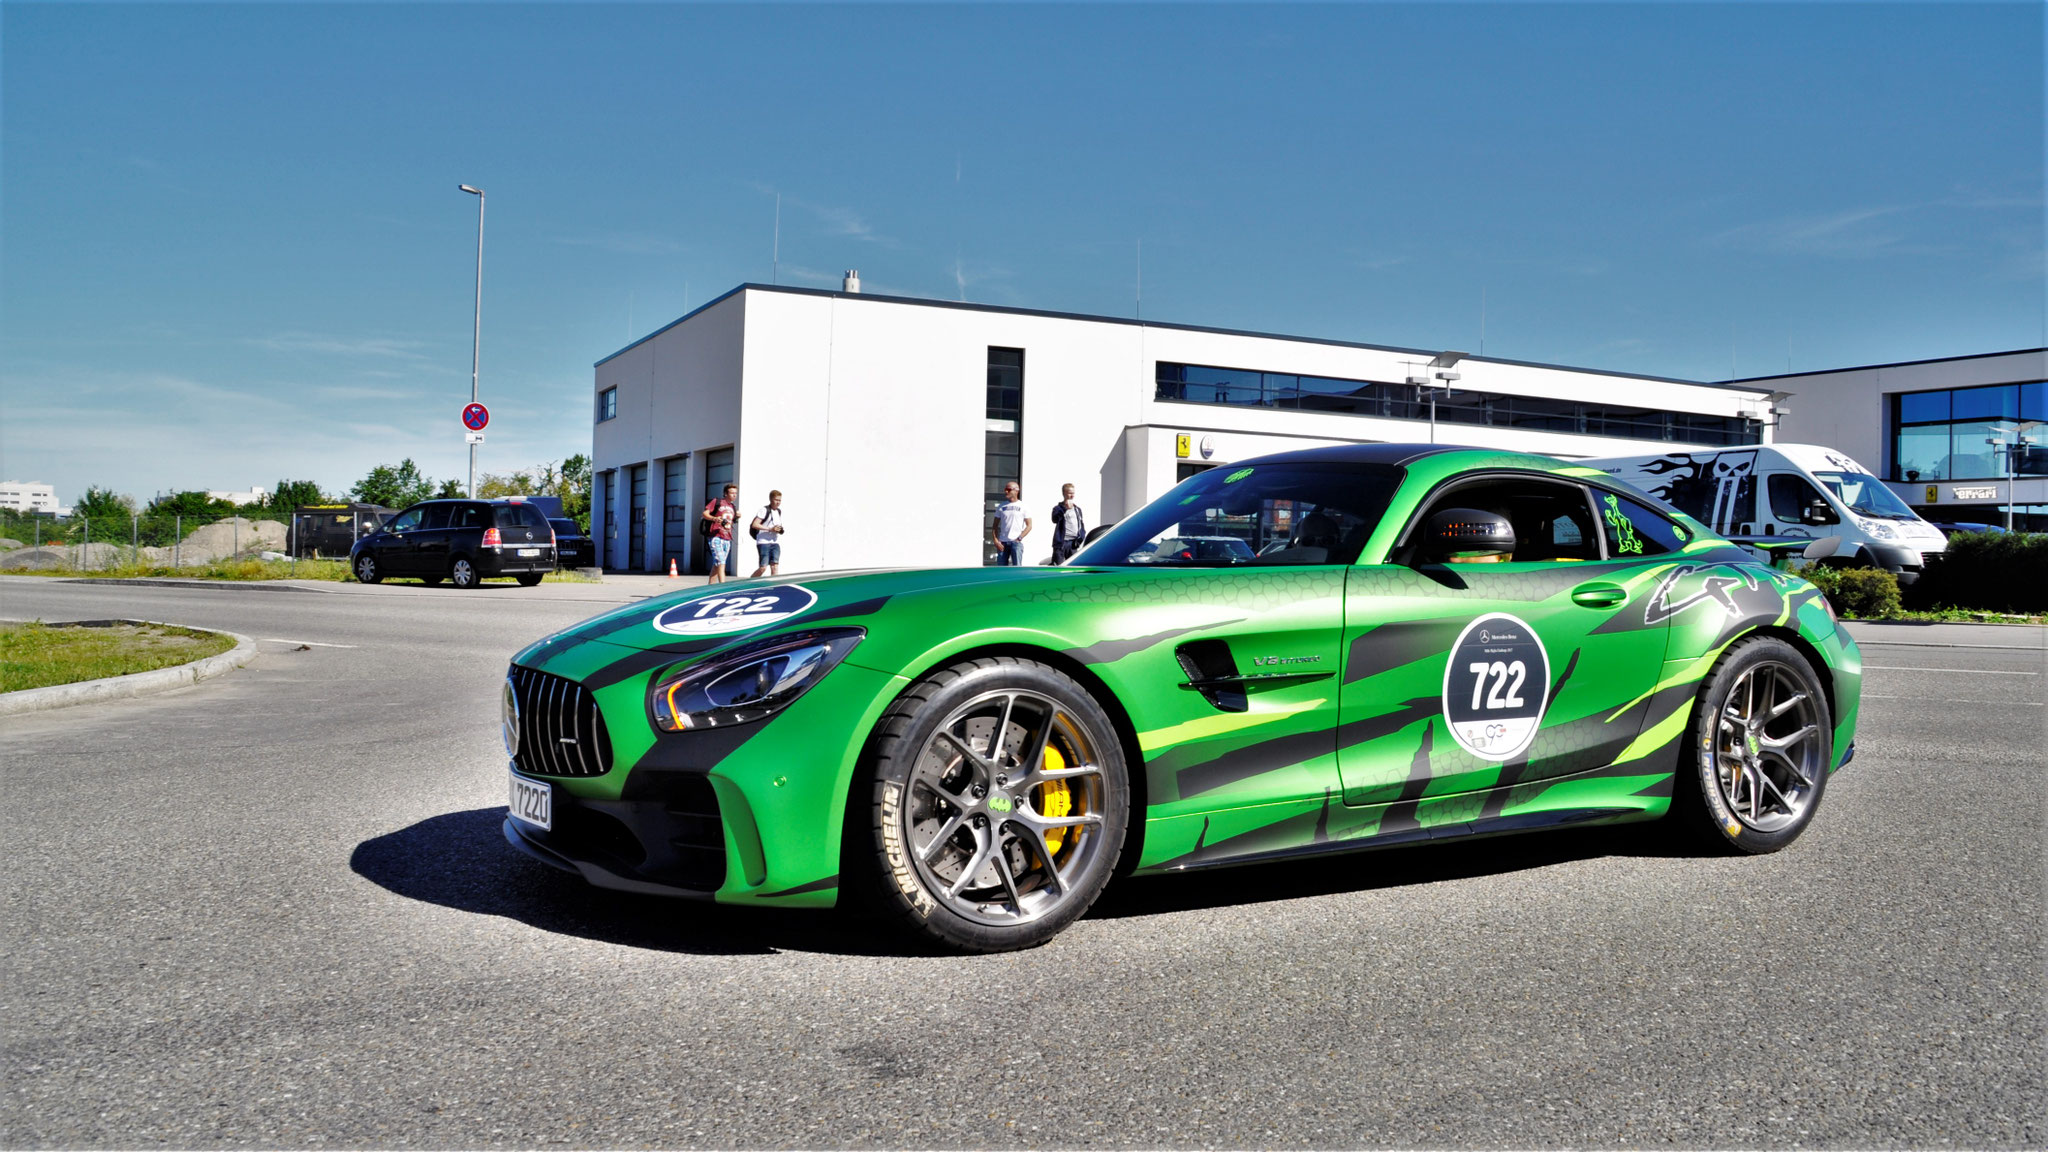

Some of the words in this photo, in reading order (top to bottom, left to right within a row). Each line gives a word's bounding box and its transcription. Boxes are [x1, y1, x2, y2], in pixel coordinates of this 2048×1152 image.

[1952, 486, 1997, 499] Ferrari
[693, 595, 780, 618] 722
[1254, 656, 1279, 666] V8
[1469, 660, 1526, 711] 722
[1703, 756, 1727, 820] MICHELIN
[883, 785, 918, 894] MICHELIN
